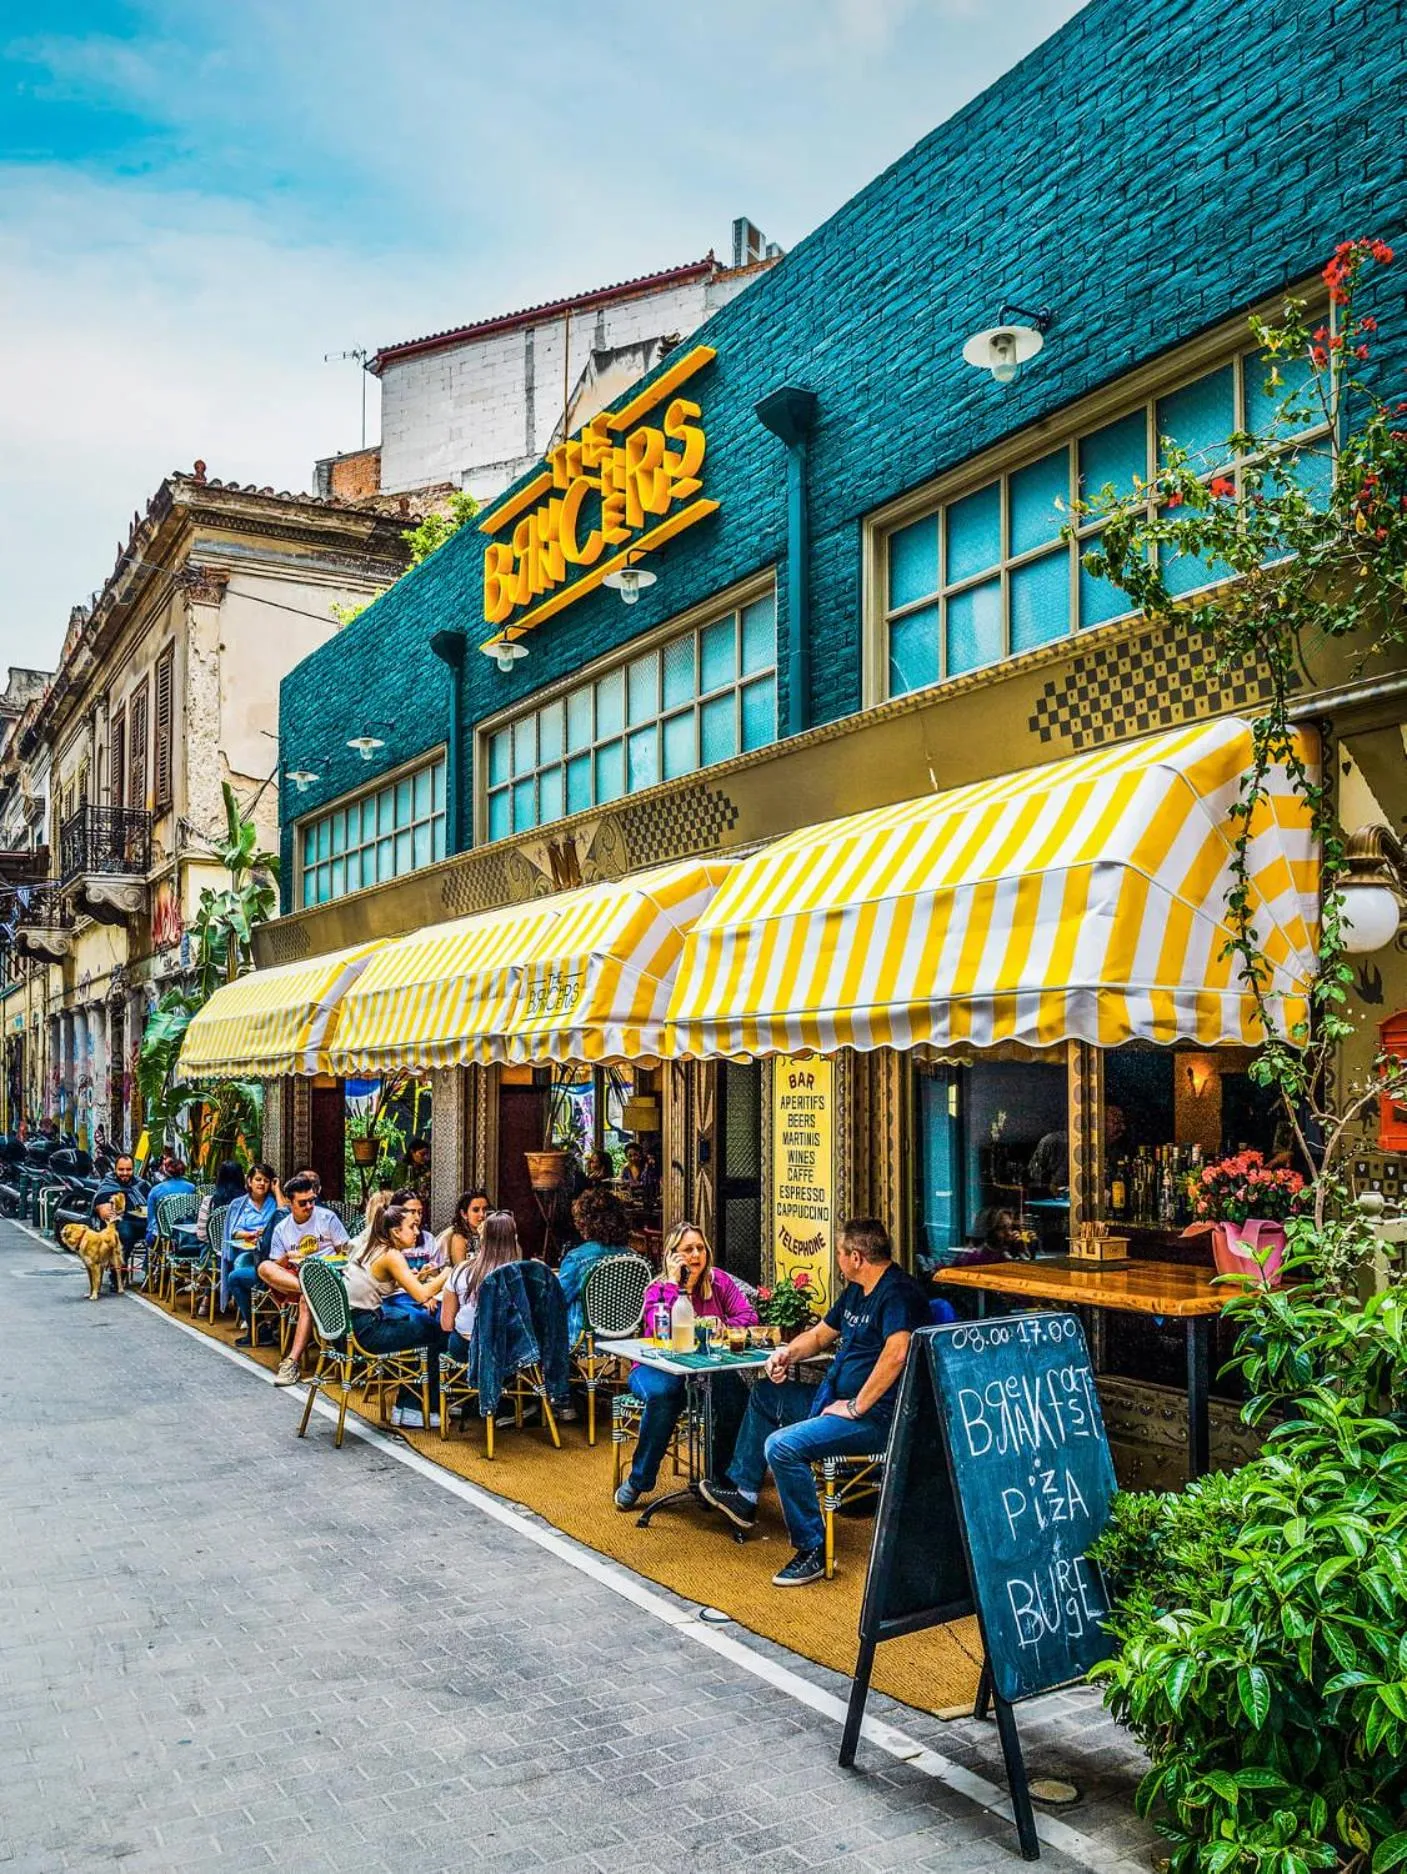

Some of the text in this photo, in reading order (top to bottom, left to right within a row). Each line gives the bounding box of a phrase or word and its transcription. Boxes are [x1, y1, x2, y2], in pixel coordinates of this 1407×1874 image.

[788, 1072, 815, 1091] BAR
[780, 1095, 825, 1111] APERITIFS
[787, 1113, 816, 1129] BEERS
[782, 1132, 820, 1147] MARTINIS
[787, 1150, 816, 1165] WINES
[787, 1167, 814, 1183] CAFFE
[779, 1185, 825, 1203] ESPRESSO
[776, 1202, 829, 1222] CAPPUCCINO
[778, 1225, 827, 1257] TELEPHONE
[952, 1319, 1077, 1353] 08.00 17.00
